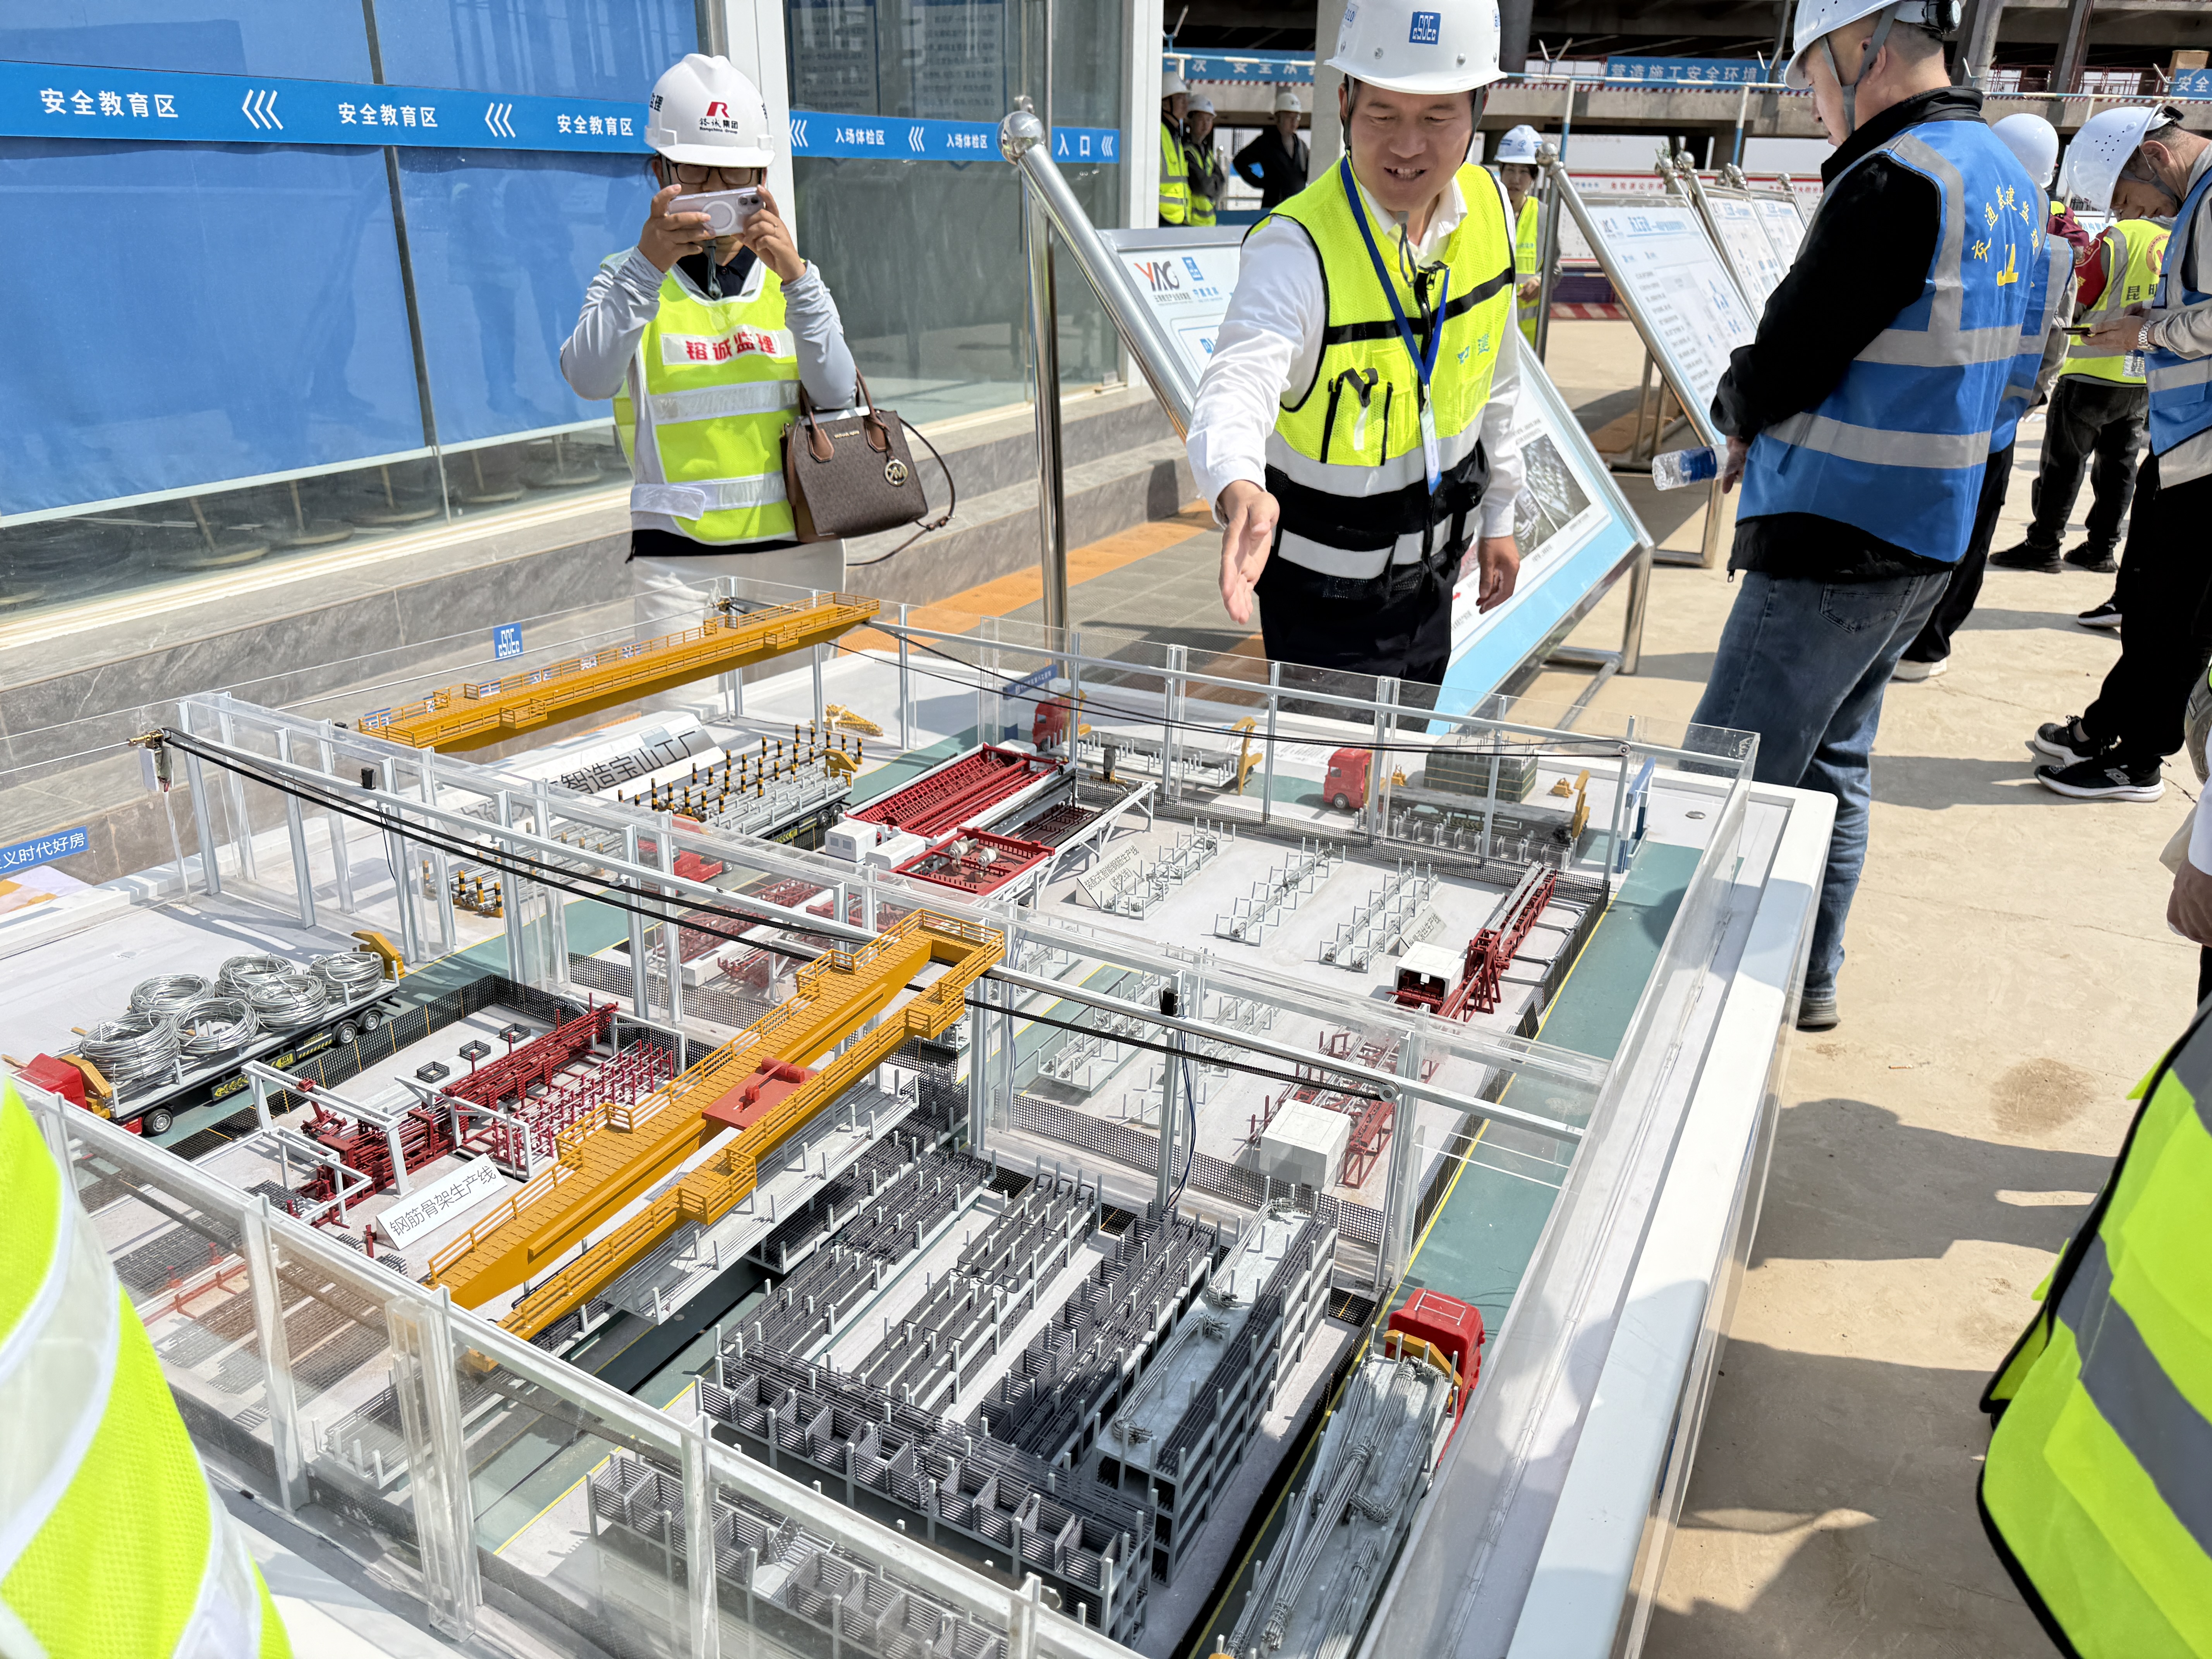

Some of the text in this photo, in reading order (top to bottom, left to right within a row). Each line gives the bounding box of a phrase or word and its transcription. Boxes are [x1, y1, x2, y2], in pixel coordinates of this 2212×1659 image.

[2176, 76, 2212, 93] 安全
[40, 88, 179, 118] 安全教育区
[338, 101, 438, 127] 安全教育区
[557, 114, 634, 136] 安全教育区
[835, 128, 885, 145] 入场体检区
[946, 134, 988, 149] 入场体检区
[1058, 133, 1090, 157] 入口
[549, 731, 696, 794] 智造宝山工厂
[1084, 845, 1139, 890] 装配式智能钢筋生产线
[390, 1165, 496, 1237] 钢筋骨架生产线
